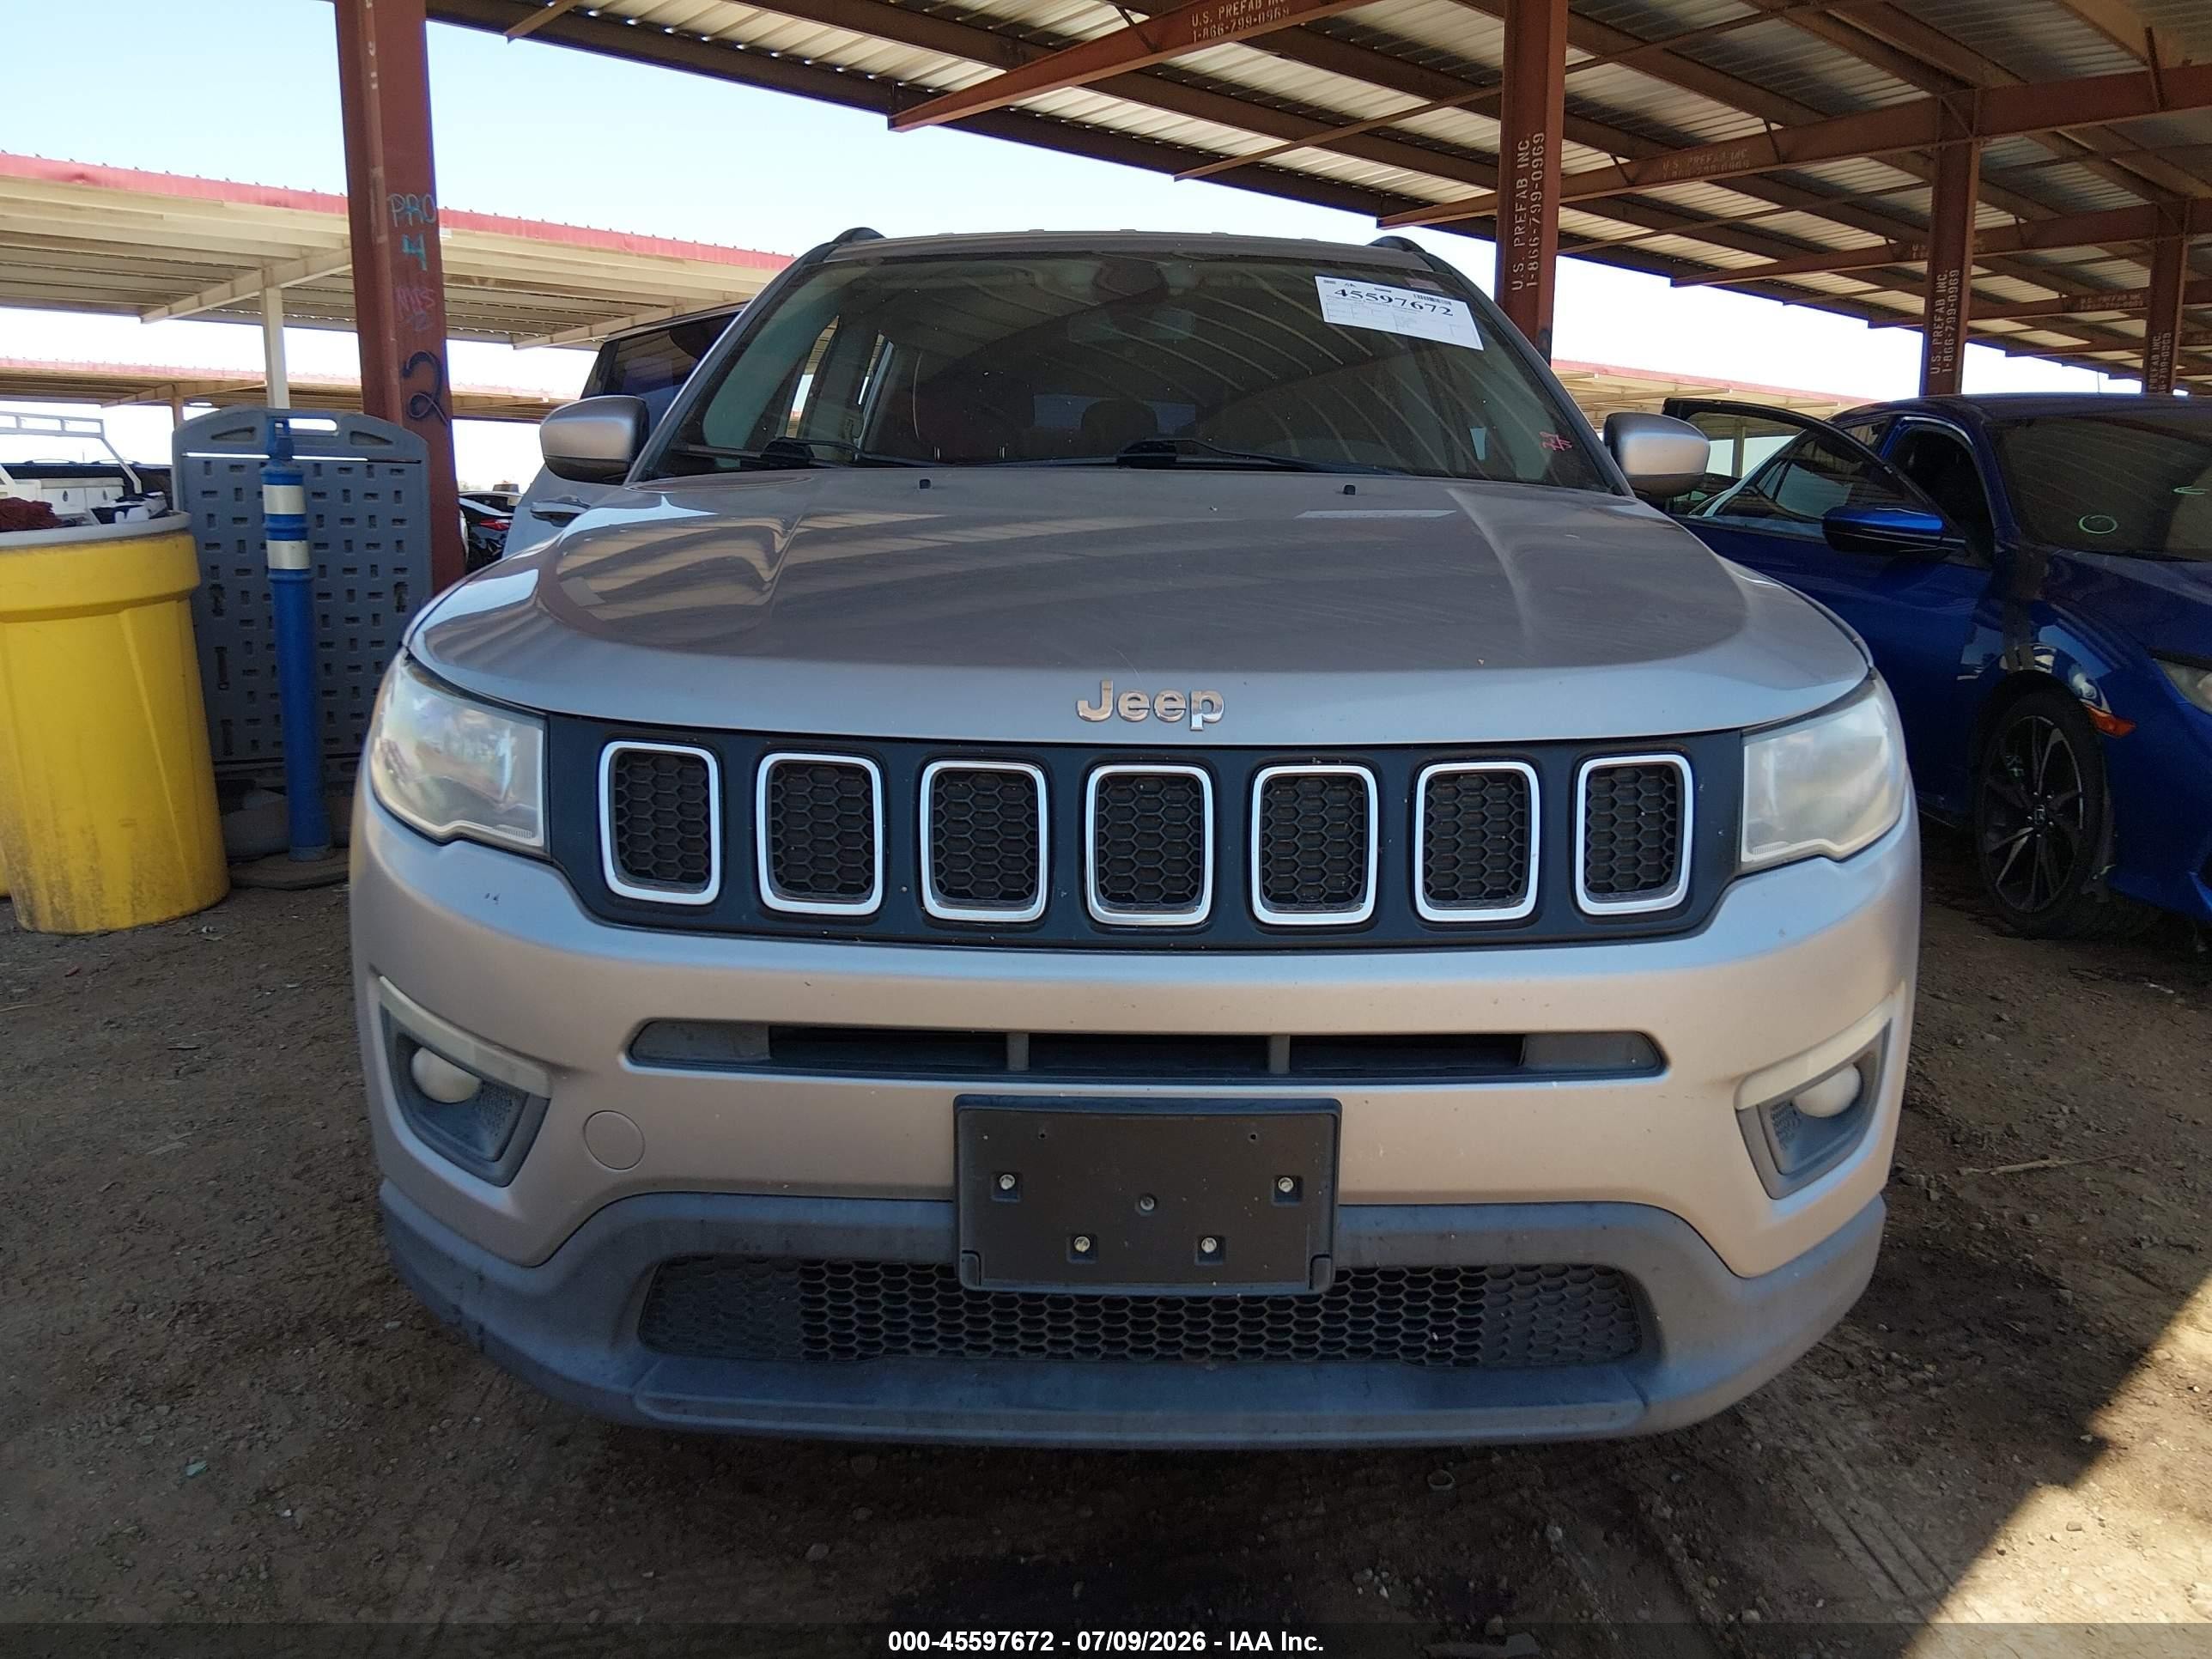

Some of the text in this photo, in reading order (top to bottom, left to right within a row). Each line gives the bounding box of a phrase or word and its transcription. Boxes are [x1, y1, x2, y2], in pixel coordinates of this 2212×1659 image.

[1191, 0, 1263, 27] U.S. PREFAB
[1513, 177, 1528, 247] PREFAB
[1526, 132, 1546, 288] 1-866-799-0969
[401, 232, 428, 272] 4
[1510, 257, 1525, 291] U.S.
[1334, 288, 1454, 317] 45597672
[1932, 297, 1947, 345] PREFAB
[1929, 349, 1942, 374] U.S.
[402, 349, 450, 428] 2
[1076, 679, 1225, 732] Jeep
